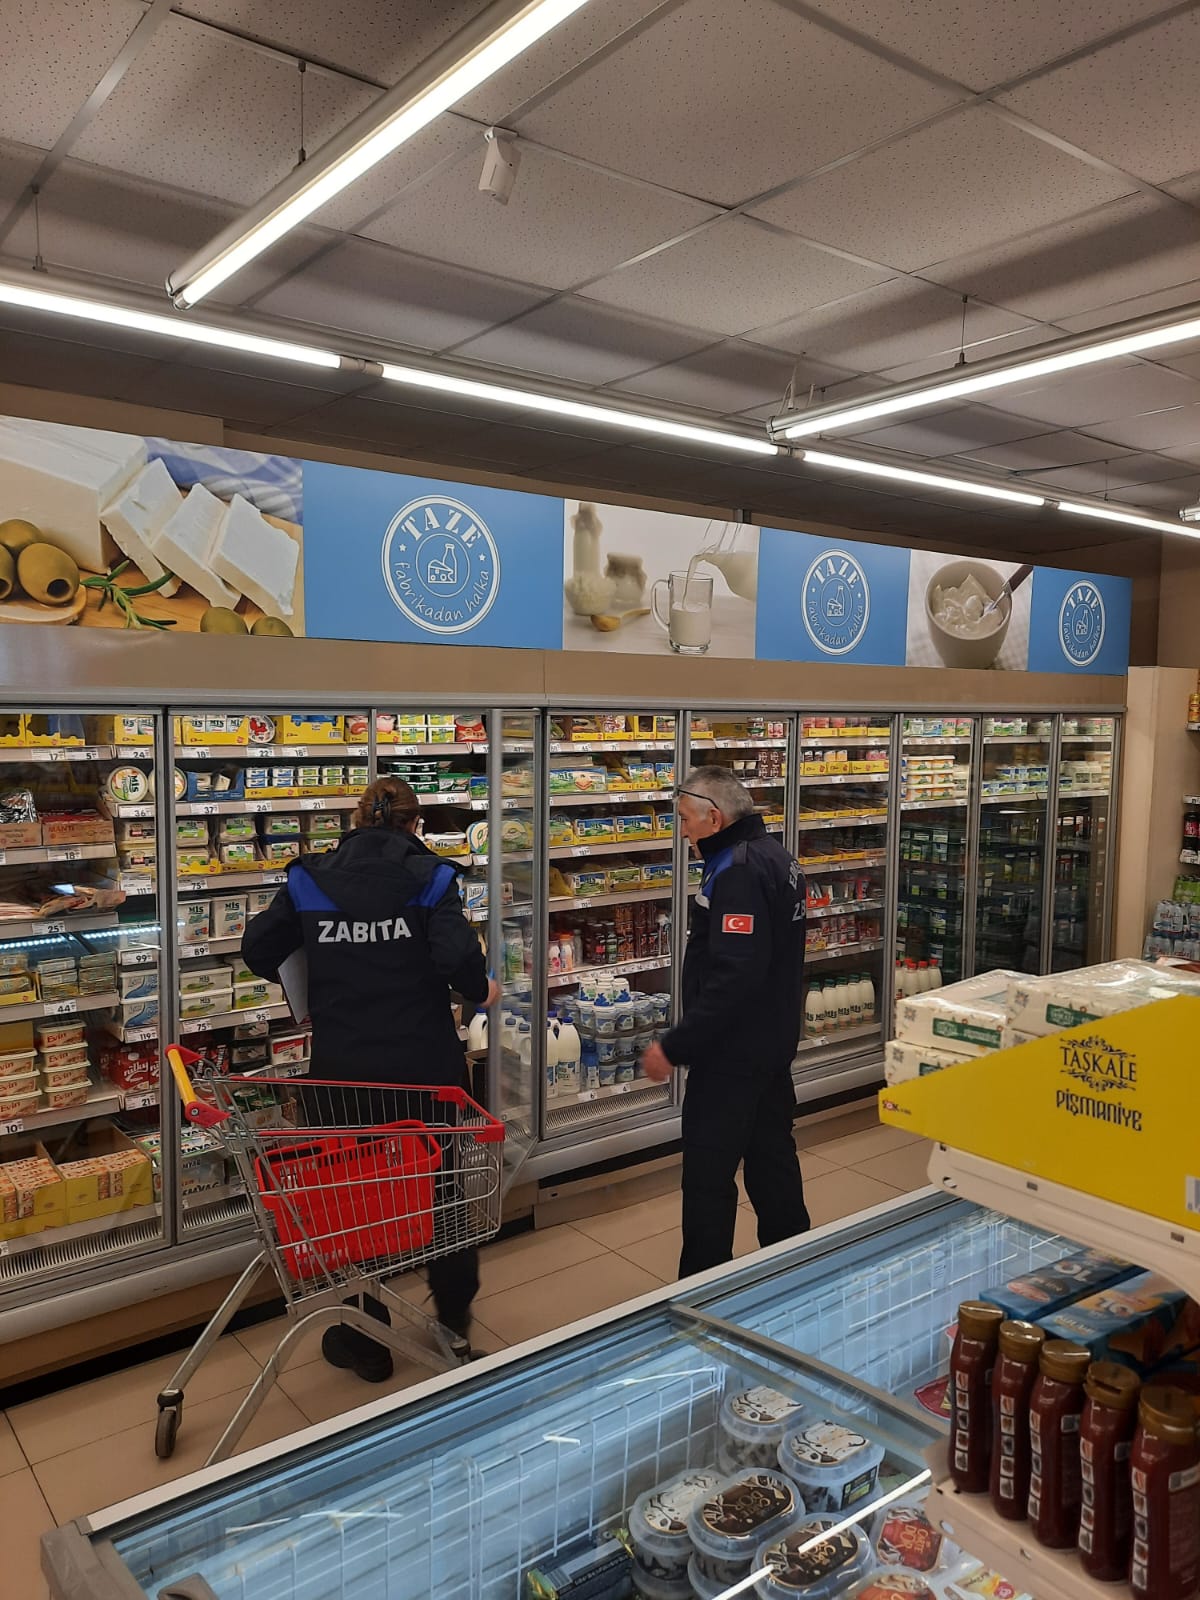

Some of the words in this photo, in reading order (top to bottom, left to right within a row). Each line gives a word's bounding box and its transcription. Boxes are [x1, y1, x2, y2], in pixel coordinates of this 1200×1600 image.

[401, 507, 482, 548] TAZE
[813, 558, 861, 588] TAZE
[394, 562, 464, 622] fabrikadan
[465, 570, 489, 612] halka
[1067, 588, 1099, 611] TAZE
[808, 600, 847, 645] fabrikadan
[848, 605, 864, 637] halka
[47, 925, 59, 933] 25
[318, 917, 412, 943] ZABITA
[136, 954, 147, 962] 99
[0, 1062, 14, 1071] vin
[1059, 1046, 1137, 1082] TAŞKALE
[142, 1098, 151, 1106] 21
[1056, 1088, 1142, 1131] PİŞMANİYE
[5, 1124, 18, 1134] 10
